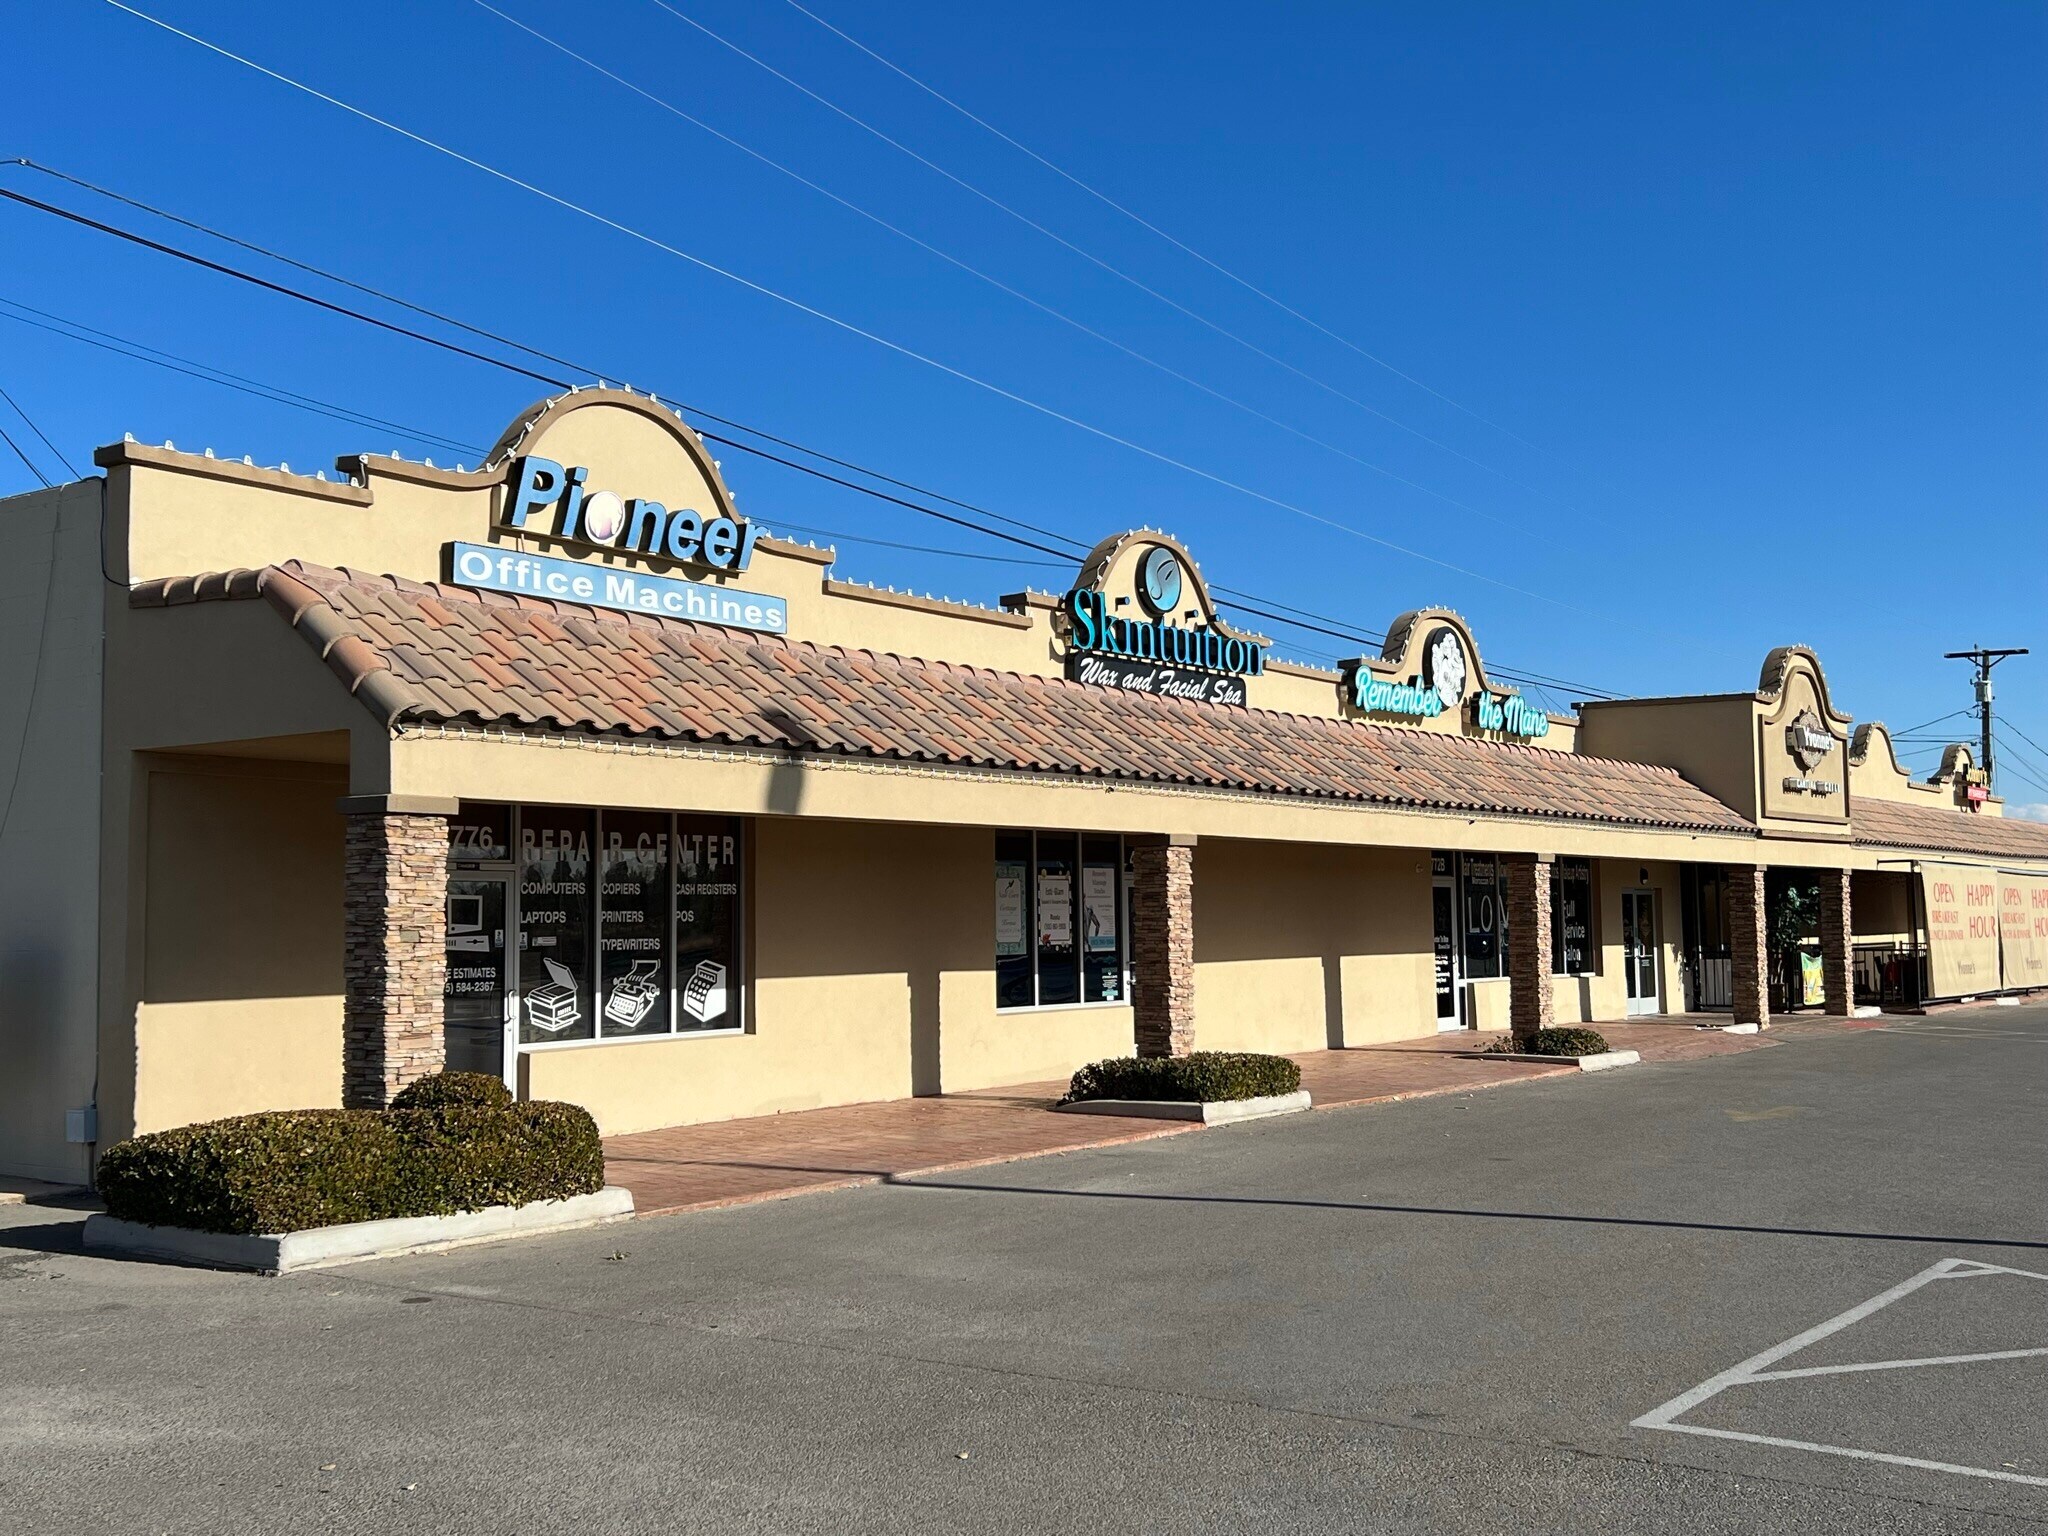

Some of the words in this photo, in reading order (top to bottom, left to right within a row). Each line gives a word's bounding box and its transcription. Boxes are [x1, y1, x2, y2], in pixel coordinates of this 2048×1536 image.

[508, 455, 769, 570] Pioneer
[459, 550, 594, 598] Office
[605, 573, 783, 629] Machines
[1071, 588, 1264, 676] Skintuition
[1079, 657, 1119, 686] Wax
[1121, 669, 1153, 692] and
[1157, 669, 1210, 700] Facial
[1209, 679, 1242, 705] Spa
[1354, 664, 1442, 718] Remember
[1478, 690, 1504, 731] the
[1503, 694, 1550, 738] Mane
[1803, 726, 1835, 751] Yvonne's
[450, 825, 493, 851] 776
[637, 832, 735, 865] CENTER
[520, 881, 586, 895] COMPUTERS
[601, 882, 641, 895] COPIERS
[675, 883, 696, 896] CASH
[696, 883, 737, 896] REGISTERS
[1933, 883, 1955, 903] OPEN
[1966, 884, 1995, 907] HAPPY
[2003, 887, 2022, 906] OPEN
[520, 910, 567, 924] LAPTOPS
[600, 910, 644, 923] PRINTERS
[675, 909, 695, 923] POS
[1969, 916, 1996, 939] HOUR
[600, 938, 661, 951] TYPEWRITERS
[1566, 945, 1581, 962] alon
[453, 967, 497, 979] ESTIMATES
[455, 981, 495, 993] 584-2367
